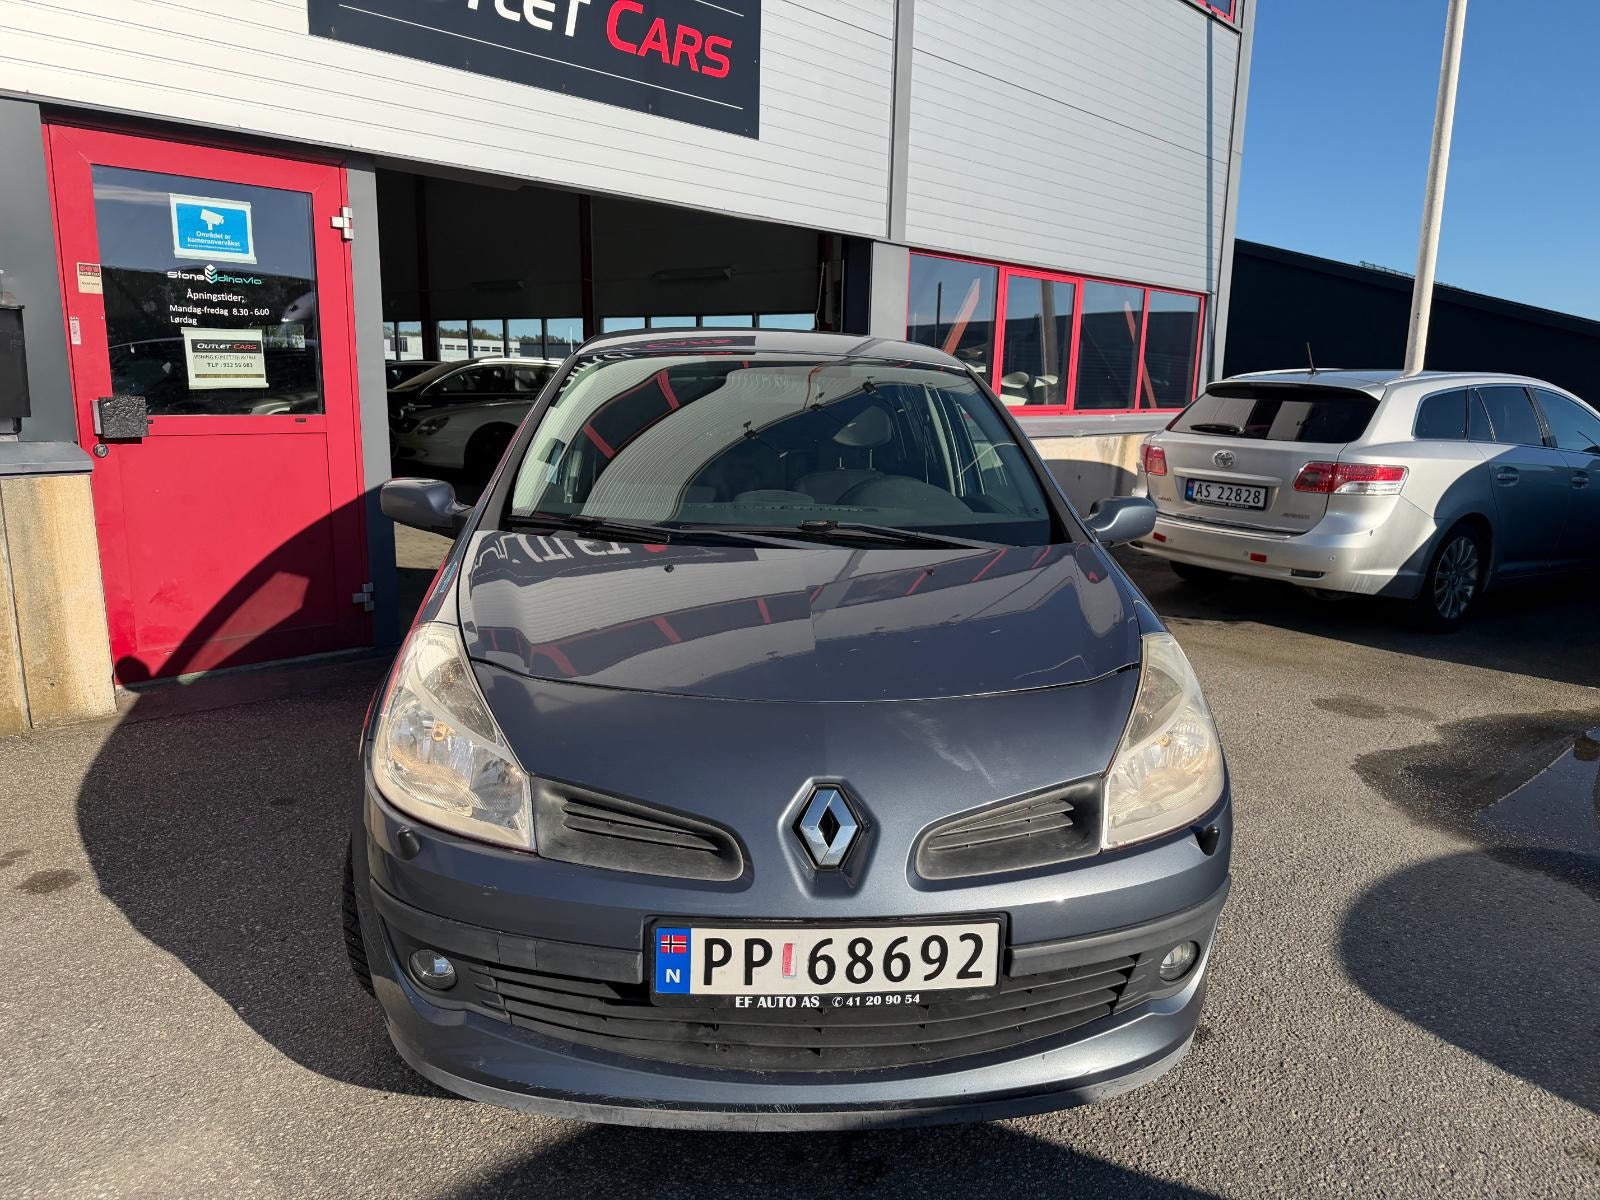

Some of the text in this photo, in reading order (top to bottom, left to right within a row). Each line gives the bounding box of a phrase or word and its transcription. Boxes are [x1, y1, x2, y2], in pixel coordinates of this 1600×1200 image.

[605, 0, 733, 79] CARS
[170, 315, 198, 325] Lørdag
[232, 308, 249, 316] 8.30
[1195, 483, 1211, 498] AS
[1217, 486, 1261, 504] 22828
[665, 932, 984, 986] N PP 68692
[735, 994, 921, 1008] EF AUTO AS 41 20 90 54
